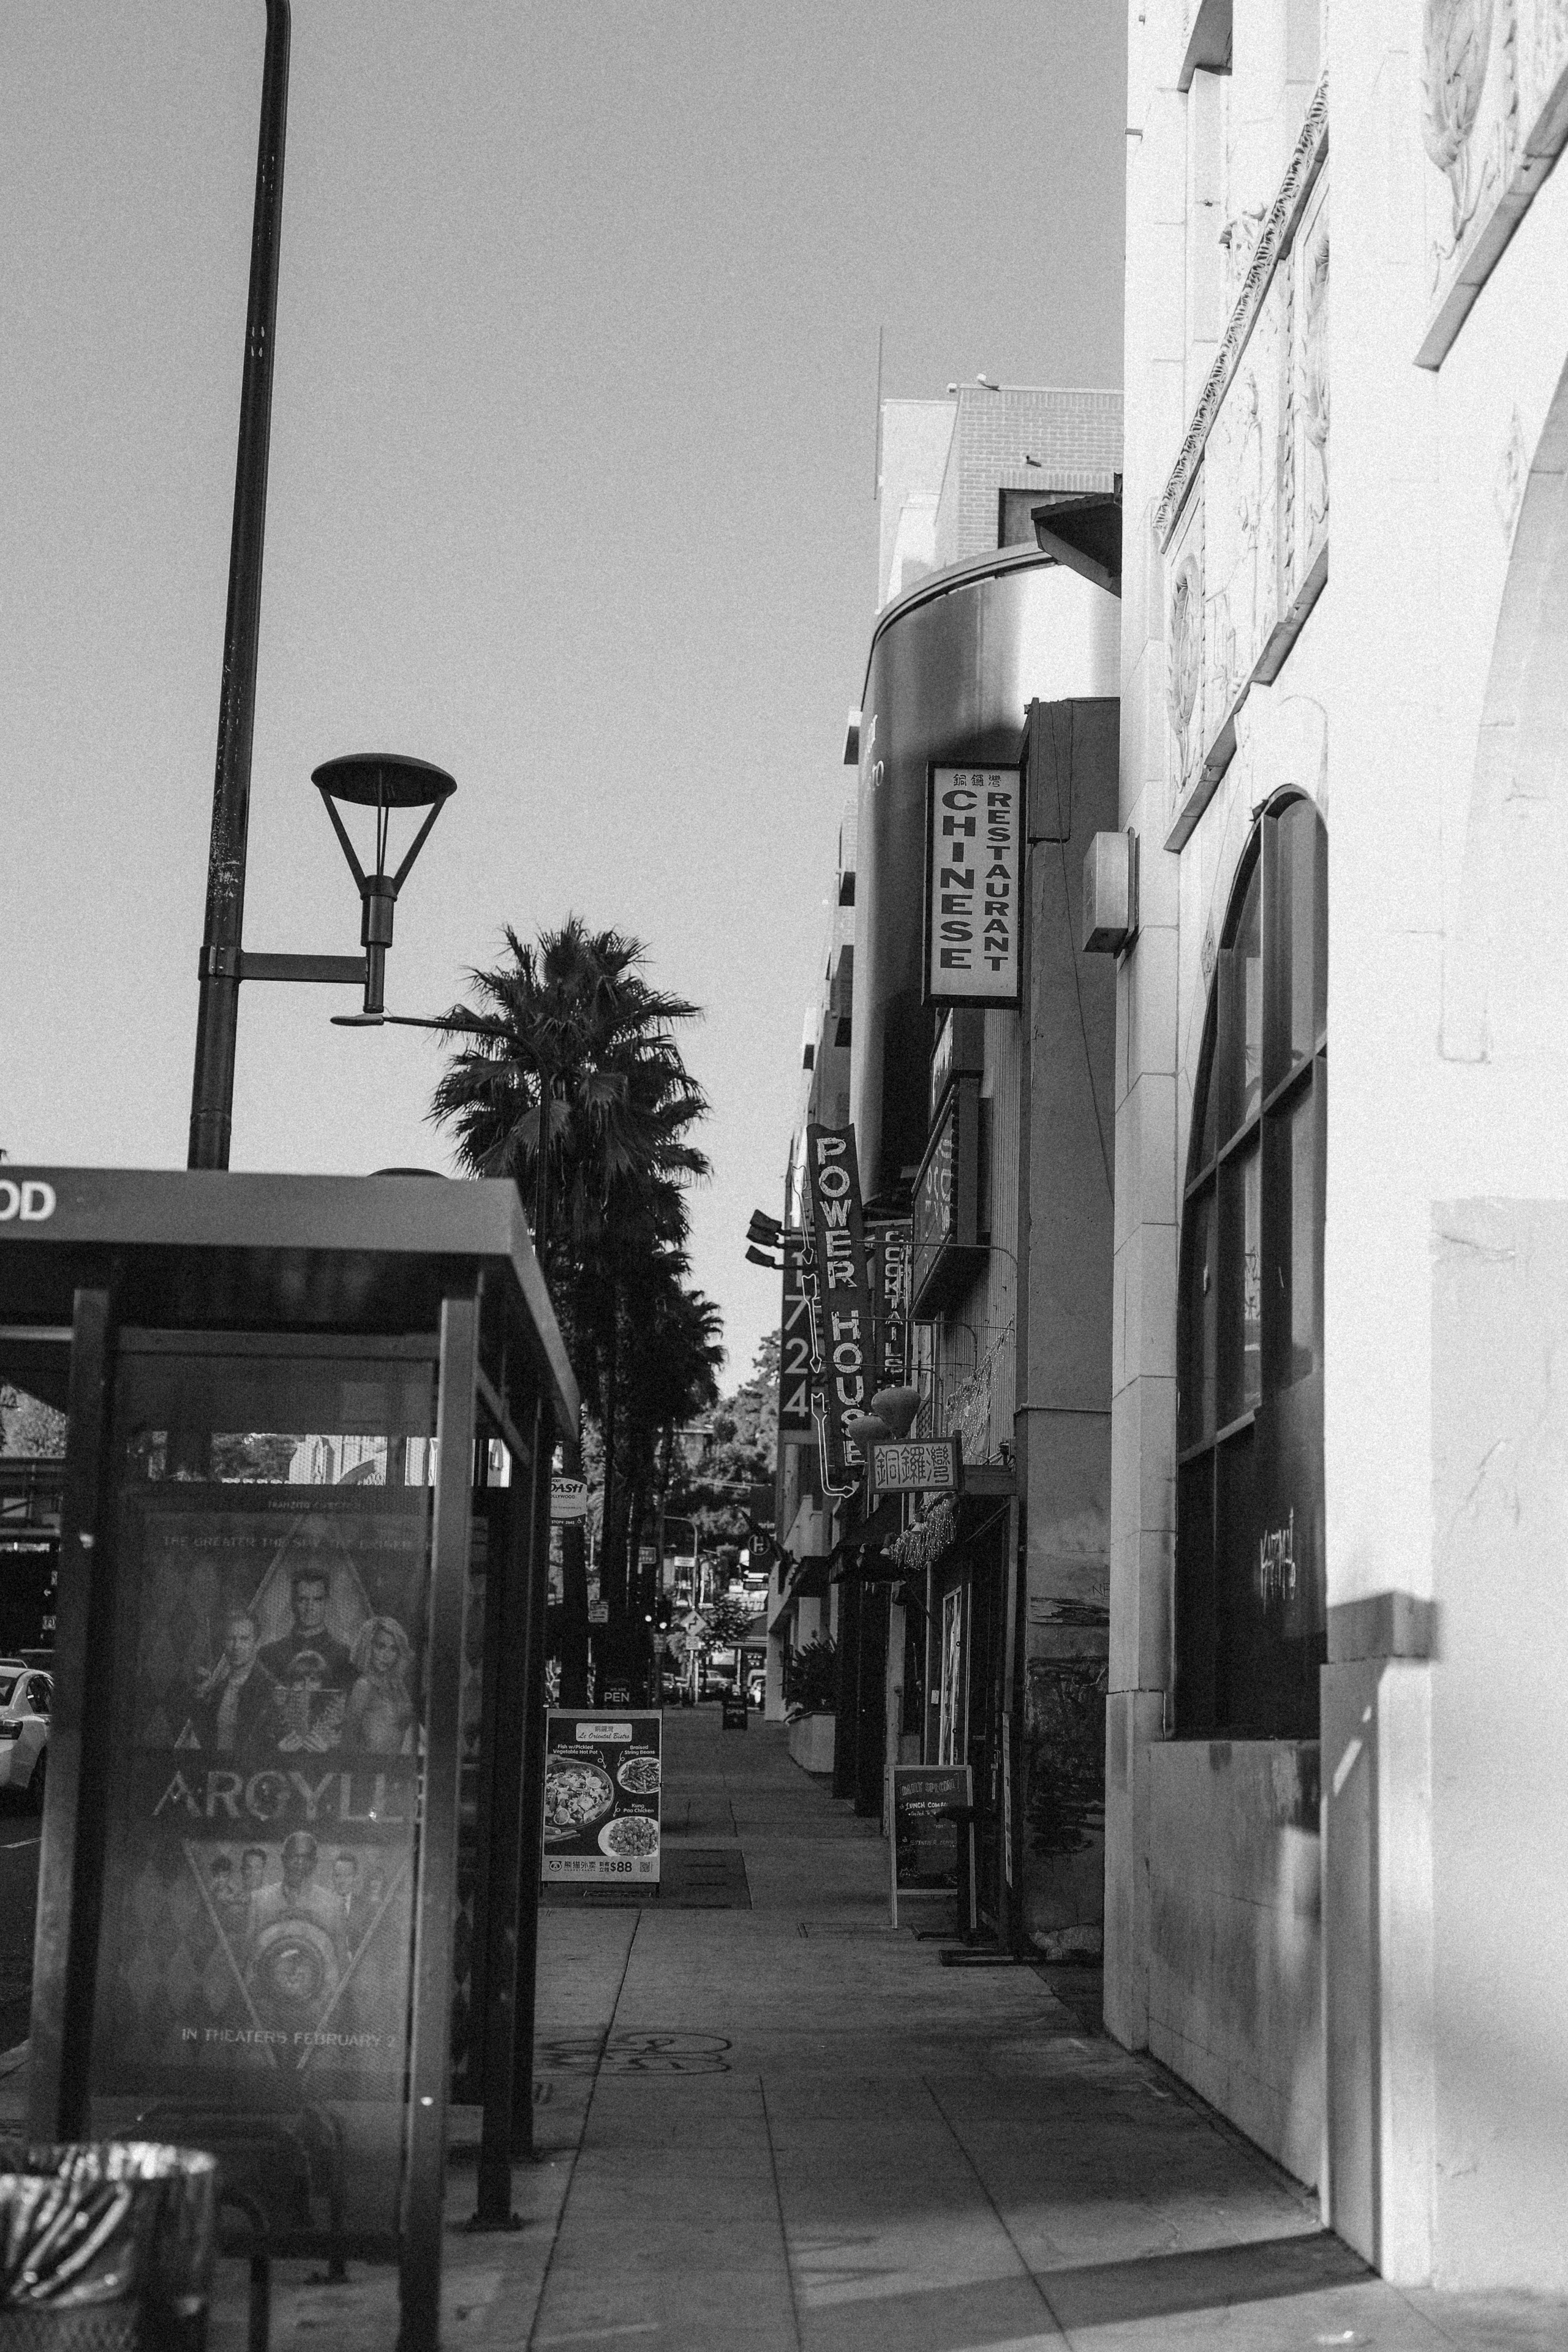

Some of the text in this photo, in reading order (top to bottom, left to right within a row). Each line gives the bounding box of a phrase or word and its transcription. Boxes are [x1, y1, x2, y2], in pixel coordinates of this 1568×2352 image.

[953, 774, 1001, 787] 銅鑼灣
[939, 790, 978, 970] CHINESE
[982, 791, 1012, 971] RESTAURANT
[816, 1137, 858, 1289] POWER
[884, 1231, 904, 1374] COCKTAILS
[782, 1251, 812, 1417] 1724
[831, 1310, 865, 1466] HOUSE
[875, 1446, 950, 1486] 銅鑼灣
[551, 1483, 583, 1493] DASH
[604, 1692, 630, 1702] PEN
[902, 1778, 956, 1796] DAILY SPECIAL
[905, 1801, 925, 1811] LUNCH
[610, 1861, 632, 1872] $88
[181, 2028, 197, 2040] IN
[204, 2028, 287, 2045] THEATERS
[293, 2031, 381, 2048] FEBRUARY
